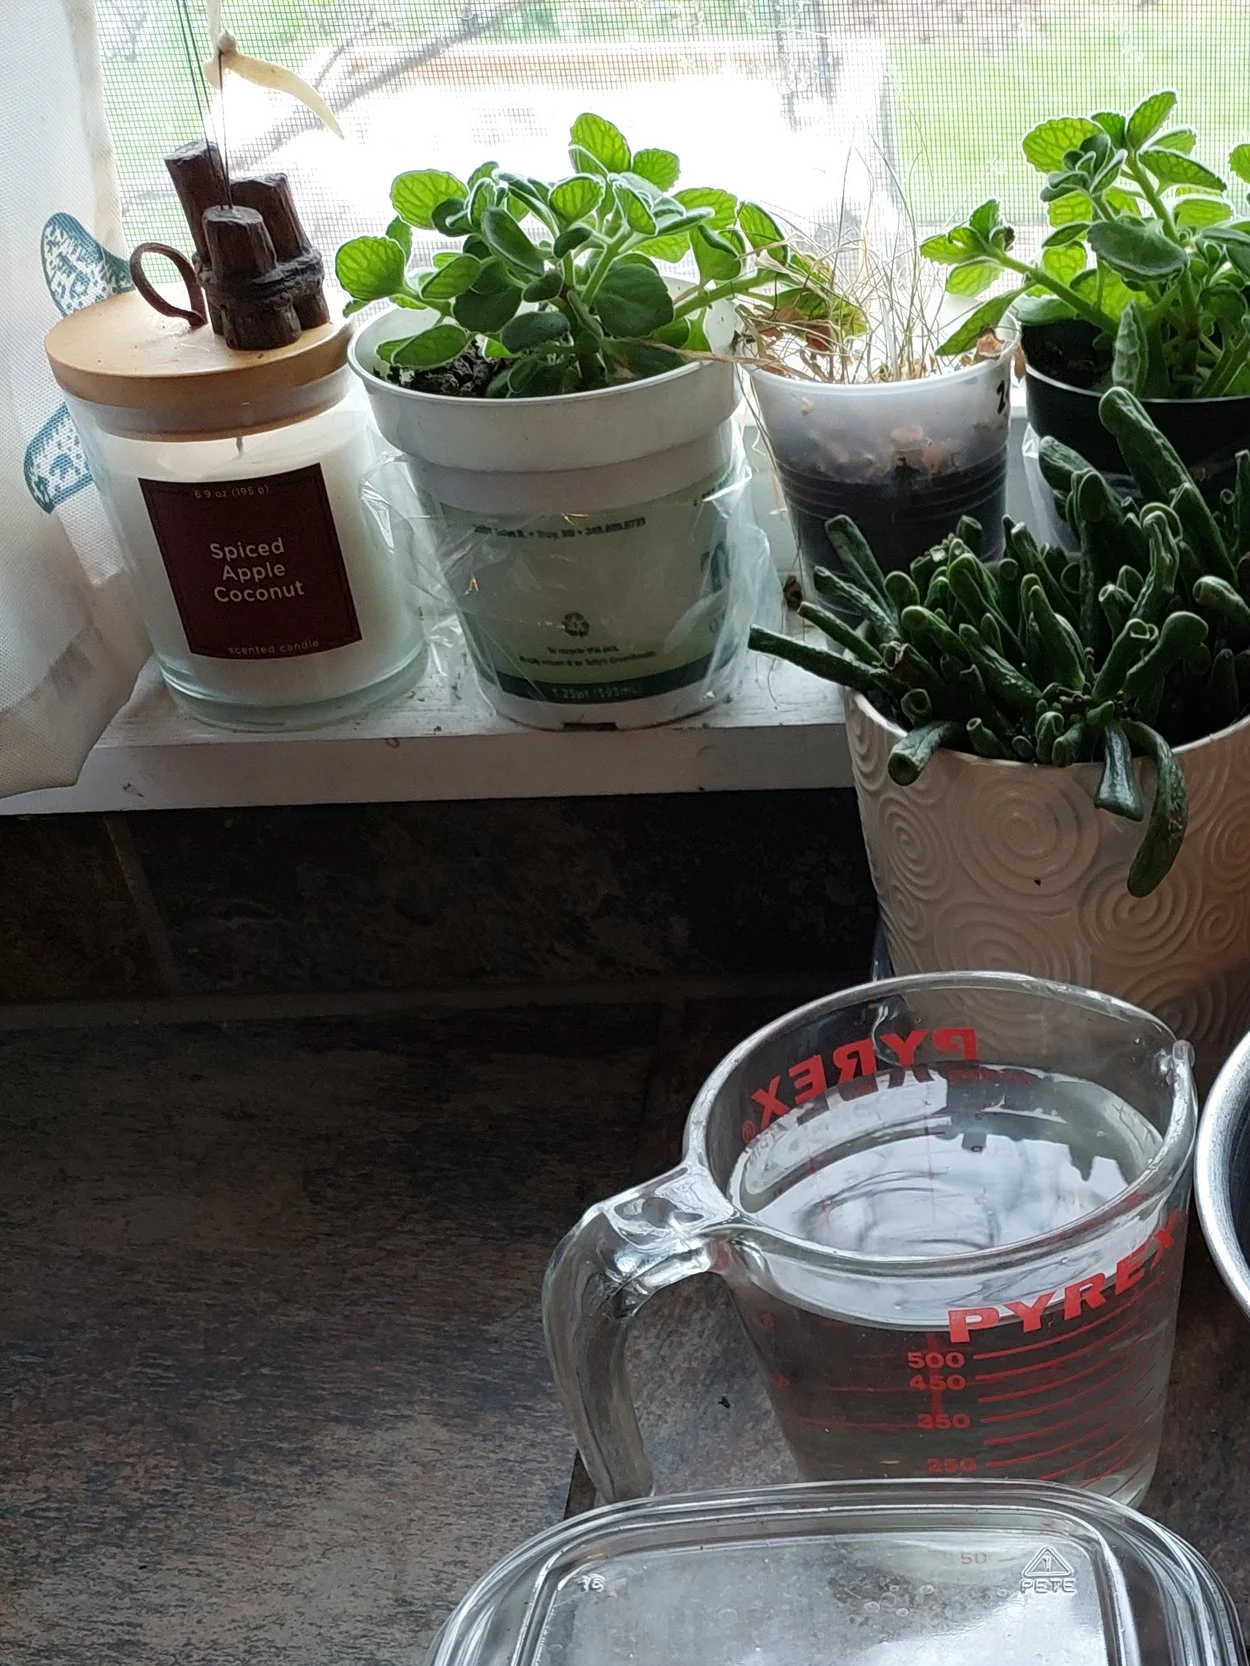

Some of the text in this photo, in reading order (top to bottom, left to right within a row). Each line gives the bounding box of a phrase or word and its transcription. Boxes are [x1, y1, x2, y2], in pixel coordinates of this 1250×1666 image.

[215, 490, 227, 499] oz
[231, 486, 254, 498] (195
[209, 537, 285, 562] Spiced
[222, 562, 286, 583] Apple
[213, 580, 305, 602] Coconut
[227, 638, 320, 655] scented candle
[947, 1209, 1184, 1344] PYREX
[907, 1351, 965, 1369] 500
[908, 1373, 968, 1391] 450
[917, 1413, 971, 1430] 350
[926, 1457, 977, 1474] 250
[1020, 1578, 1077, 1594] PETE
